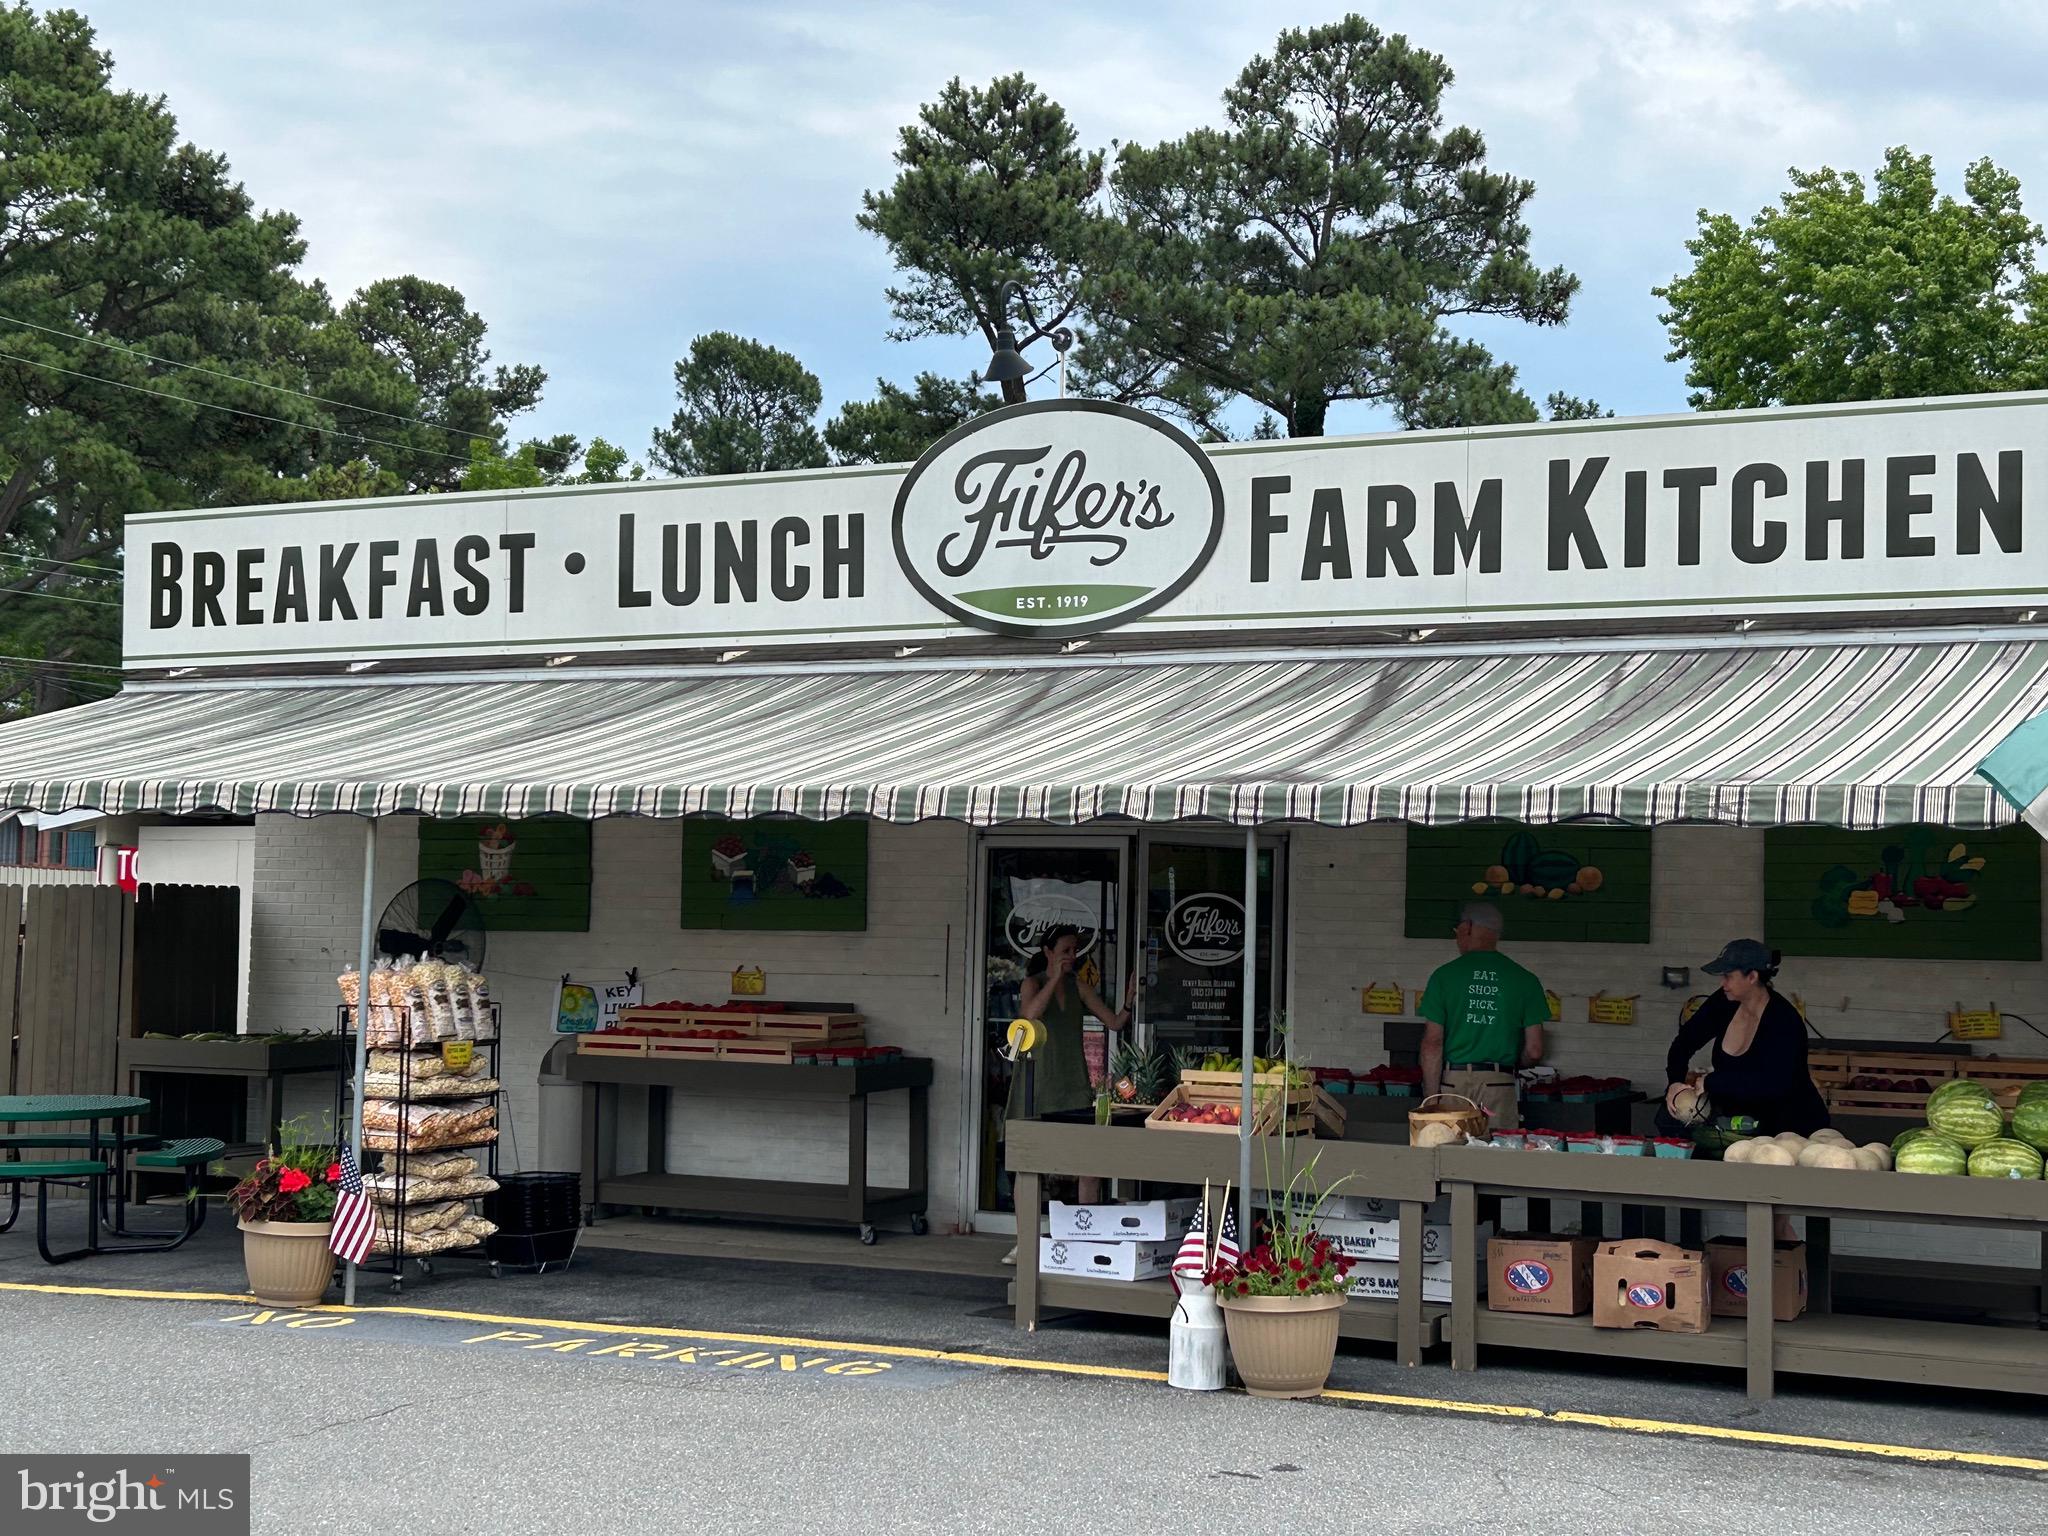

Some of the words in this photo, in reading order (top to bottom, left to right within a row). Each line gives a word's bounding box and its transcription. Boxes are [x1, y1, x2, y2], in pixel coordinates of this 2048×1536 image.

[936, 445, 1175, 577] Fifer's
[1250, 474, 1502, 583] FARM
[1547, 449, 2023, 571] KITCHEN
[150, 532, 536, 630] BREAKFAST
[618, 512, 865, 609] LUNCH
[1016, 597, 1051, 610] EST.
[1057, 595, 1089, 609] 1919
[117, 850, 139, 881] TO
[1178, 906, 1241, 946] Fifer's
[605, 985, 634, 998] KEY
[604, 1002, 635, 1015] LI
[1344, 1236, 1377, 1249] BAKERY
[1378, 1278, 1399, 1289] BAK
[221, 1310, 357, 1329] NO
[461, 1330, 893, 1376] PARKING
